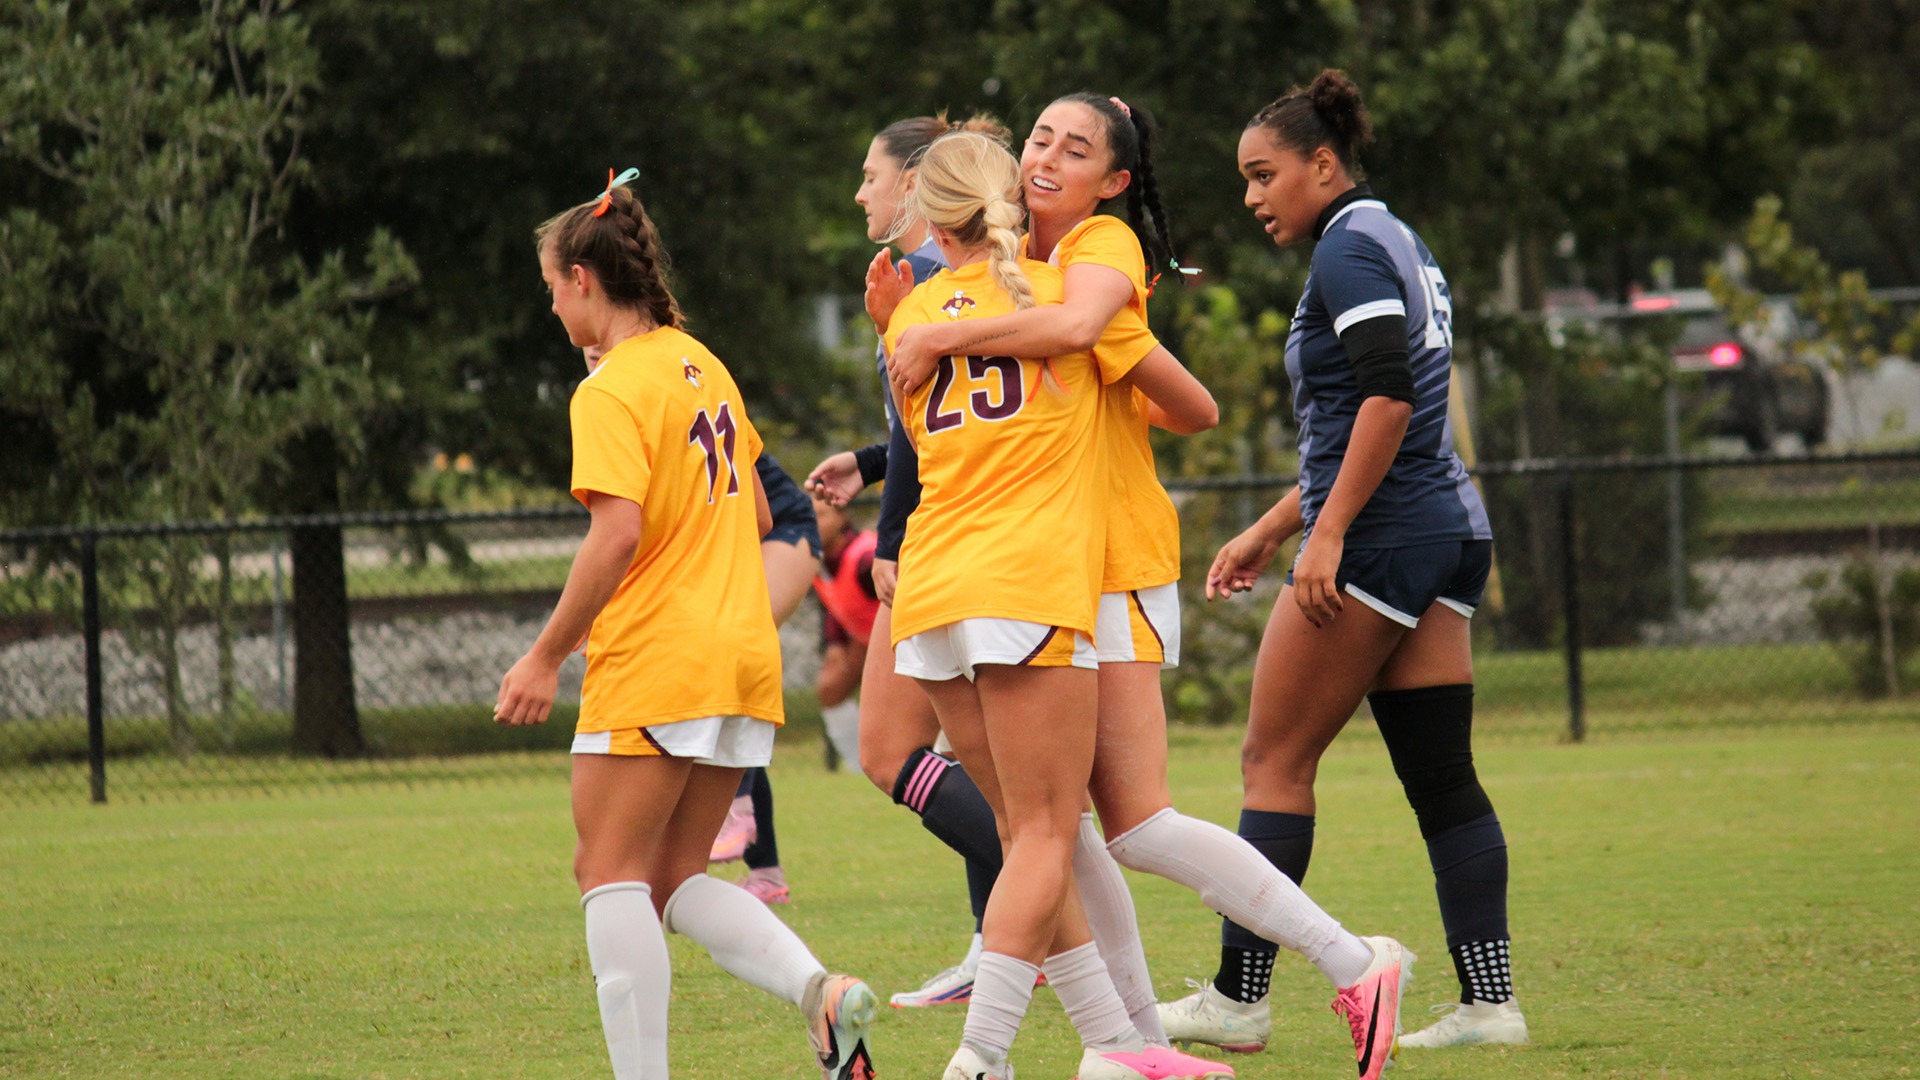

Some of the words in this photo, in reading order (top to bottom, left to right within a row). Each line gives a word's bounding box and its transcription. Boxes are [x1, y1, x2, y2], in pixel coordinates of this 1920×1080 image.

[1417, 264, 1453, 350] 15
[924, 355, 1025, 436] 25
[688, 400, 740, 505] 11
